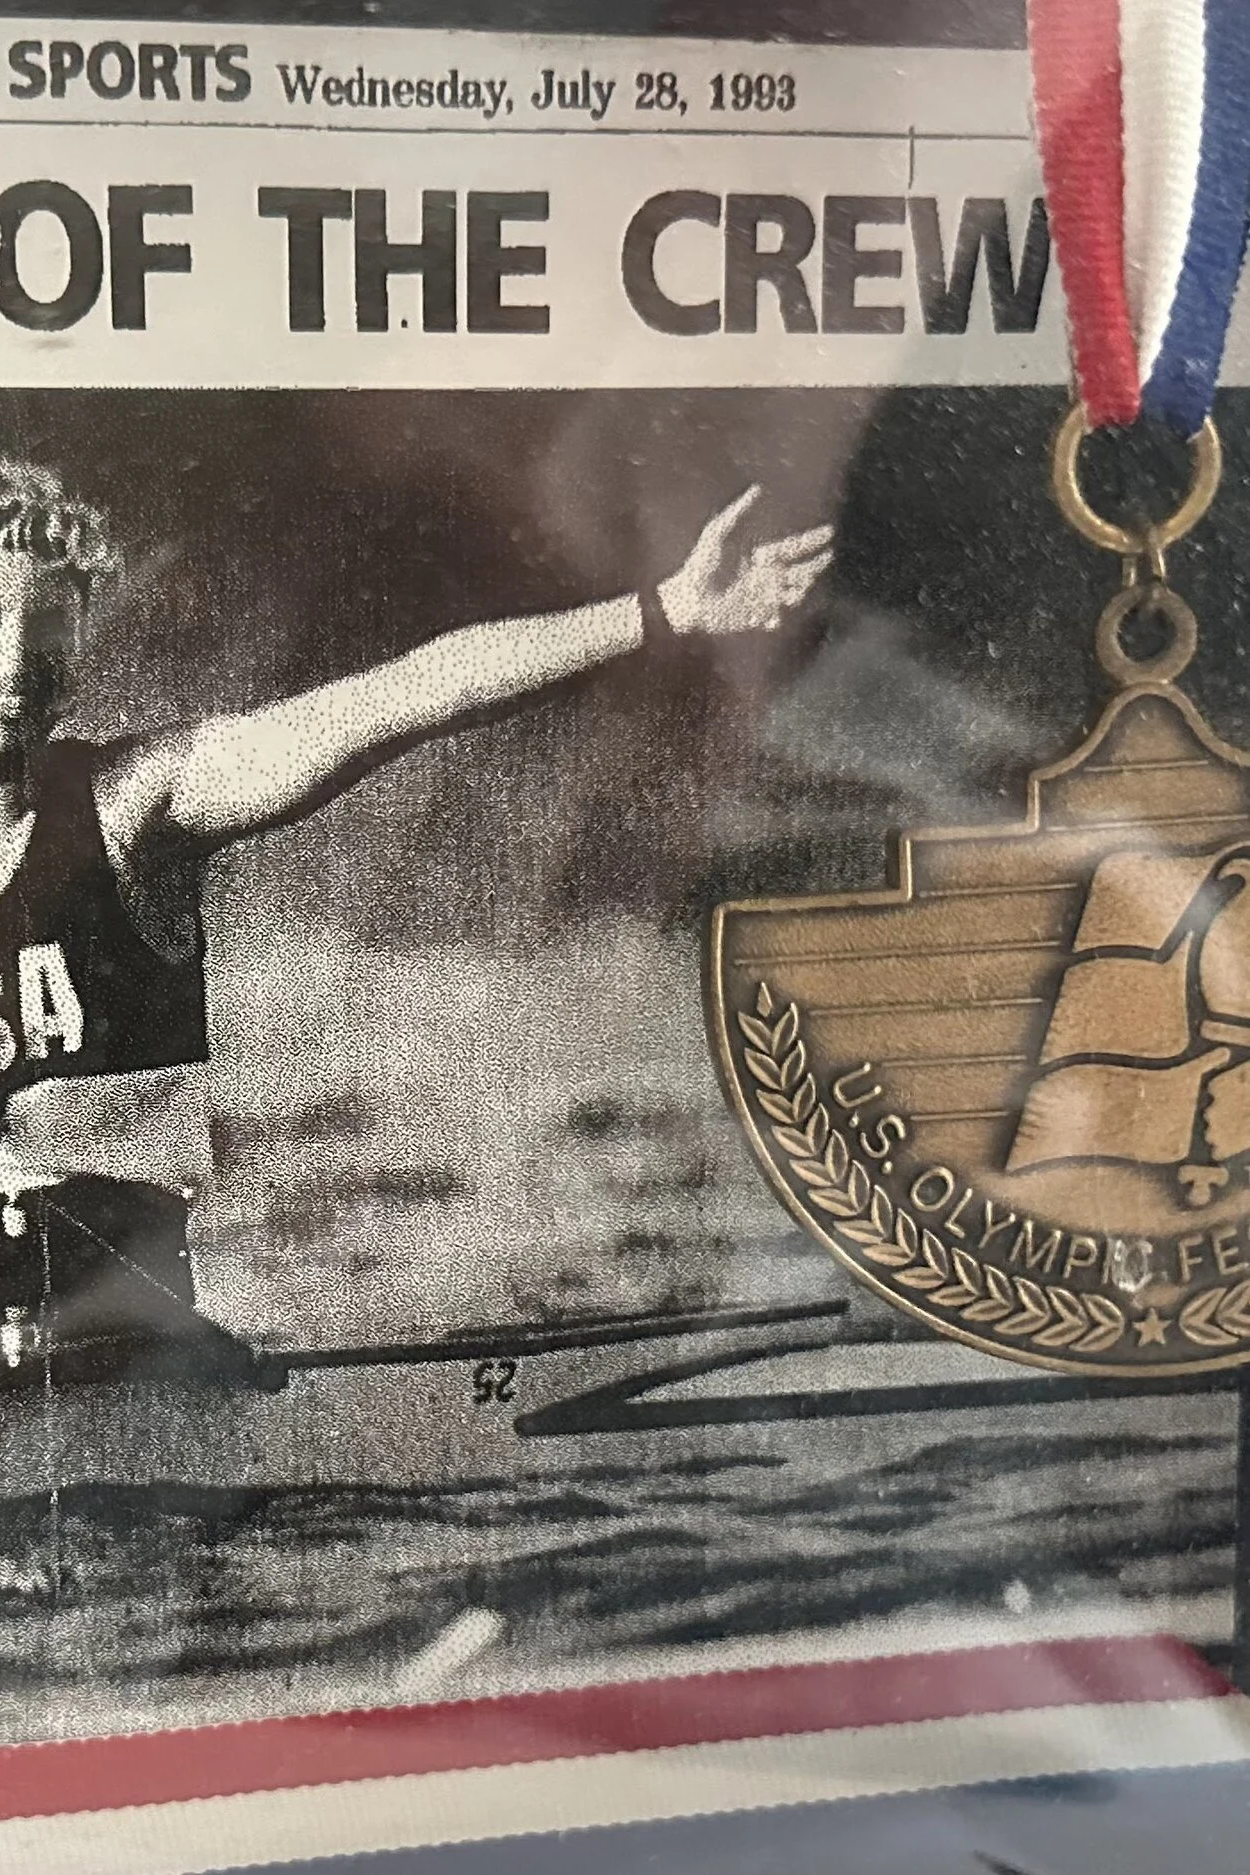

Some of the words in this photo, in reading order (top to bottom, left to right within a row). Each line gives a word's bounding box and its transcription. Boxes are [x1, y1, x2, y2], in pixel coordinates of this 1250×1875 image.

[8, 40, 251, 103] SPORTS
[276, 63, 515, 119] Wednesday,
[530, 68, 617, 121] July
[634, 71, 688, 117] 28,
[707, 73, 796, 112] 1993
[257, 186, 550, 334] THE
[621, 188, 1051, 335] CREW
[833, 1061, 907, 1175] U.S.
[910, 1165, 1153, 1293] OLYMPIC
[1177, 1226, 1250, 1284] FE
